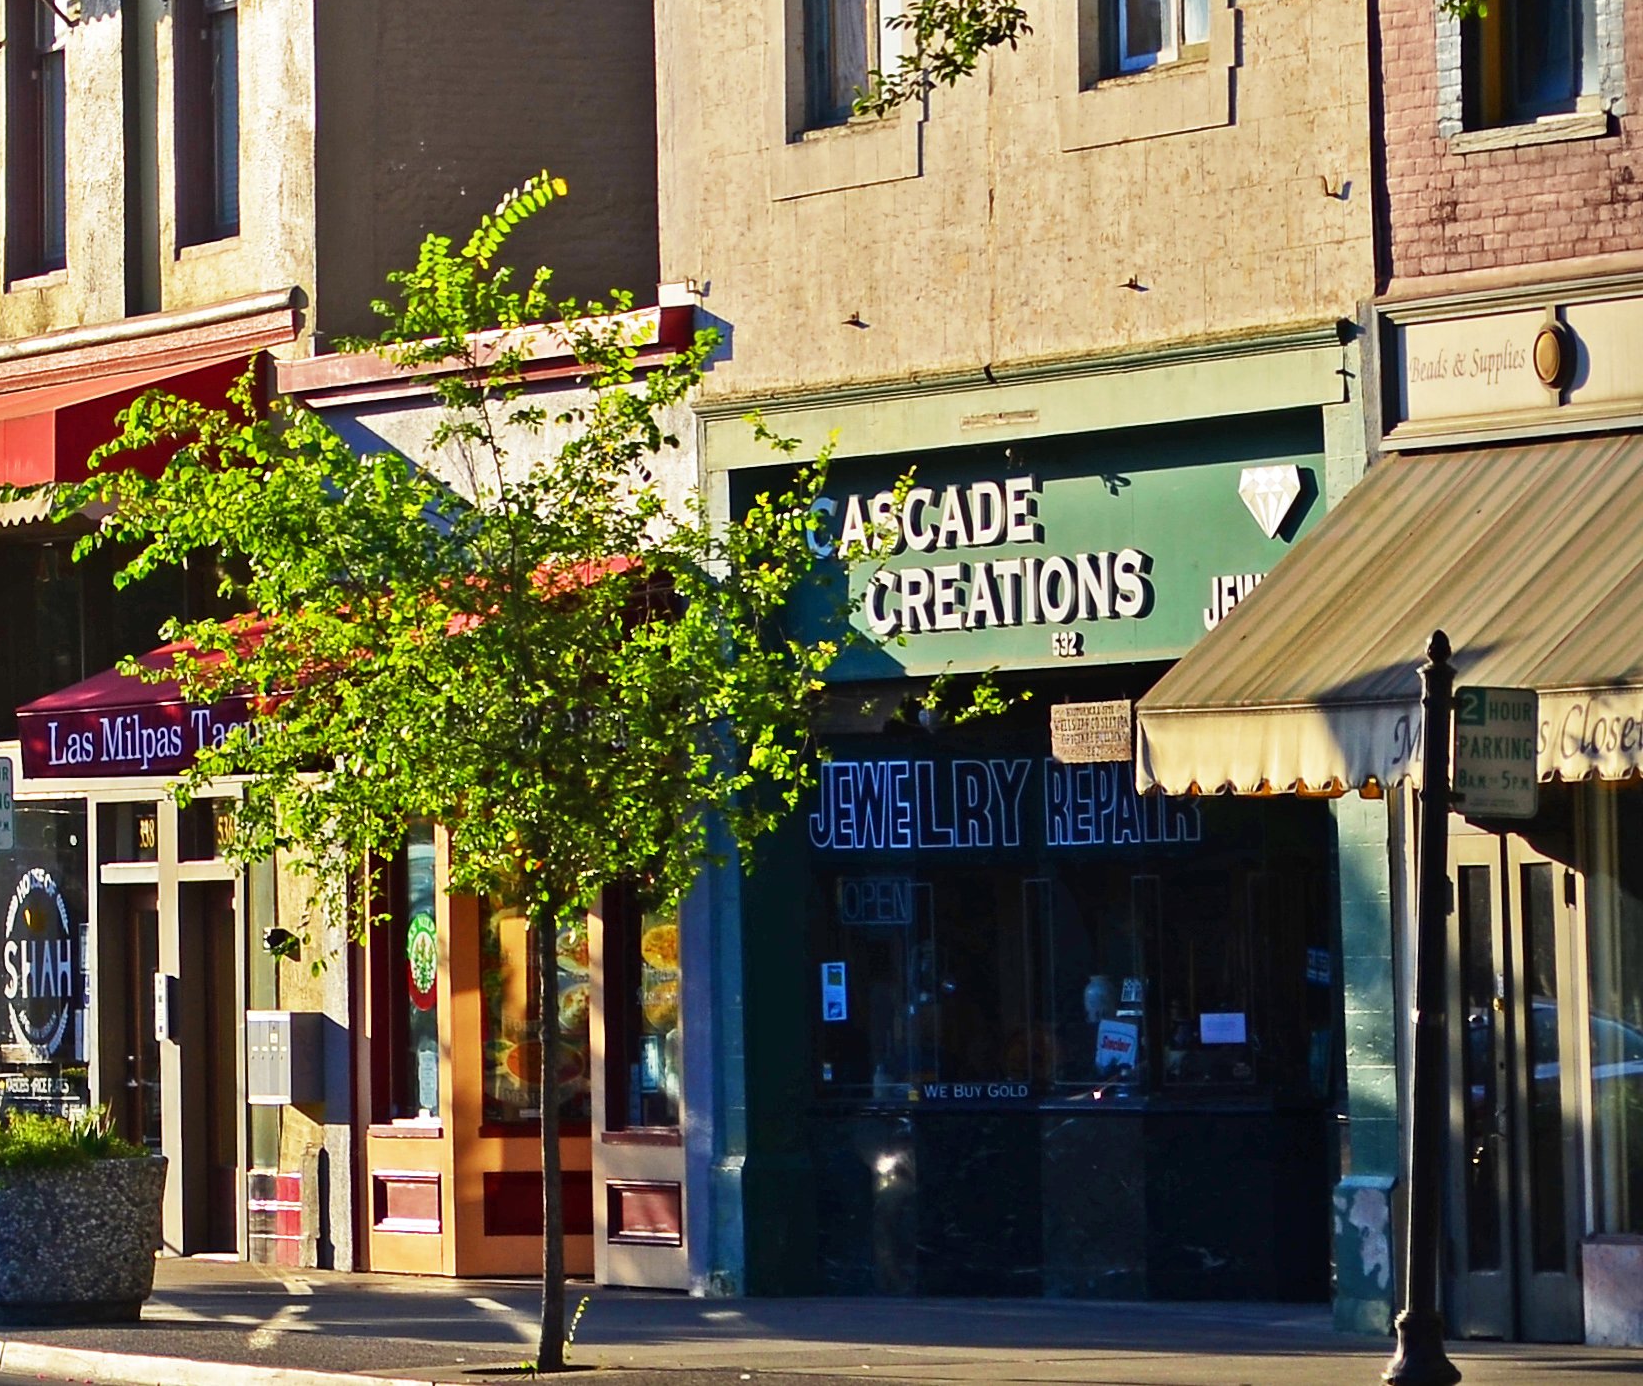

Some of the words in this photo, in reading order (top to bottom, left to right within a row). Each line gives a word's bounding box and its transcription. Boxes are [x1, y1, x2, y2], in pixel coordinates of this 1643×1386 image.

[1409, 348, 1447, 383] Beads
[1453, 353, 1465, 377] &
[1471, 339, 1526, 385] Supplies
[806, 475, 1037, 560] CASCADE
[865, 548, 1145, 635] CREATIONS
[1051, 632, 1078, 657] 532
[1461, 693, 1479, 720] 2
[1489, 702, 1532, 721] HOUR
[48, 721, 94, 765] Las
[100, 714, 182, 770] Milpas
[1458, 736, 1532, 761] PARKING
[809, 759, 1032, 850] JEWELRY
[1044, 759, 1202, 846] REPAIR
[844, 881, 910, 921] OPEN
[4, 939, 72, 1000] SHAH
[924, 1084, 948, 1098] WE
[954, 1084, 982, 1098] BUY
[988, 1083, 1028, 1098] GOLD
